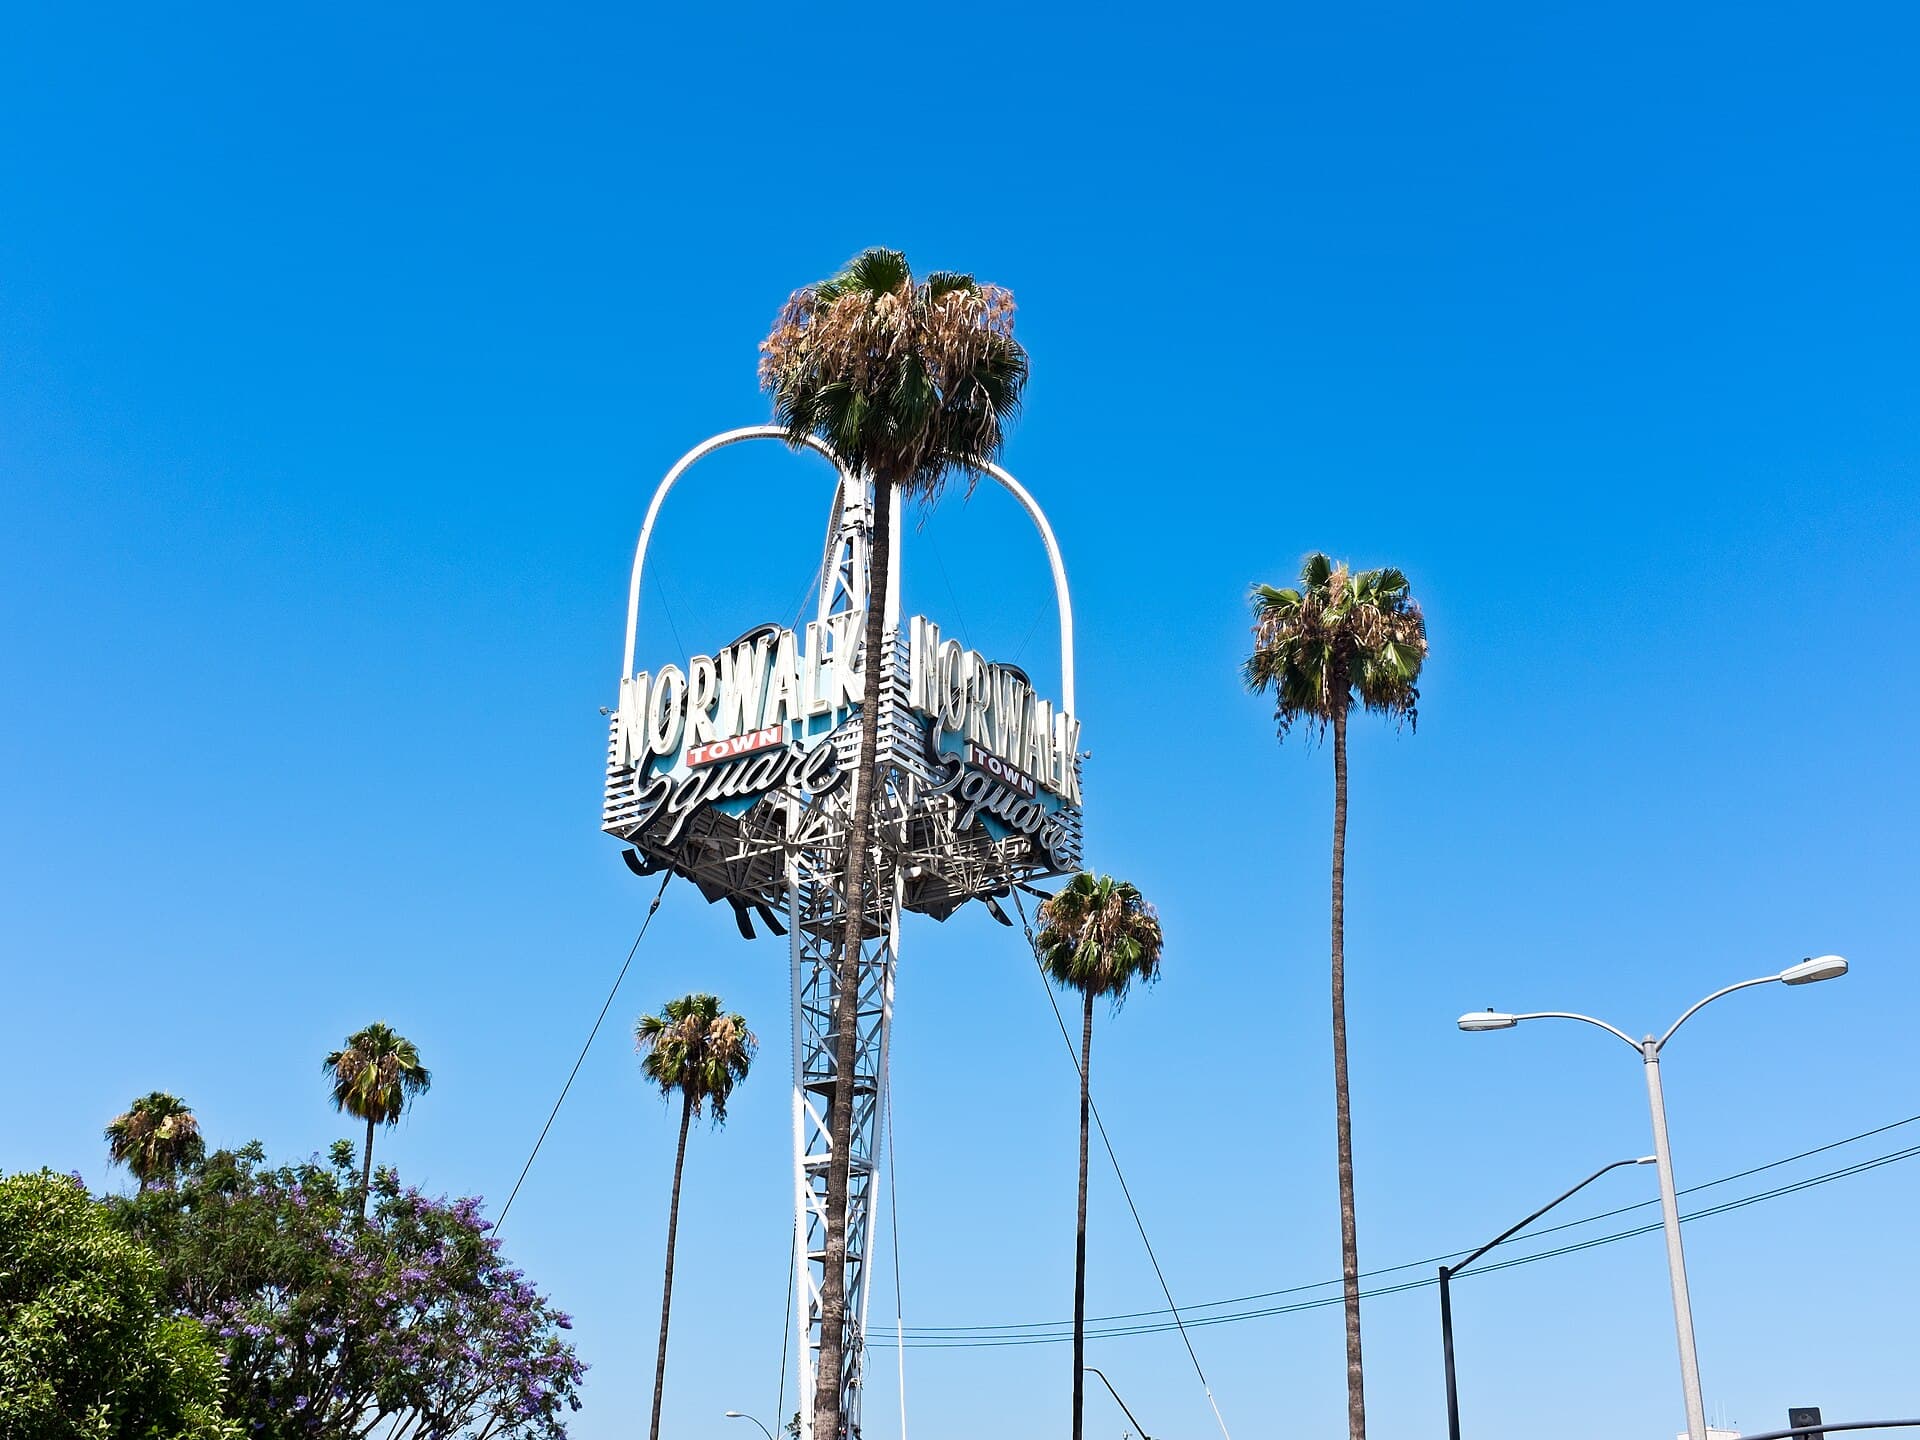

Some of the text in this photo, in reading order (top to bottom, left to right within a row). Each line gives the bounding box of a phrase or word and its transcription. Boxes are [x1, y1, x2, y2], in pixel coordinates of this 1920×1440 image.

[615, 609, 867, 768] NORWALK
[690, 727, 780, 764] TOWN
[910, 615, 1082, 806] NORWALK
[625, 722, 850, 847] Square
[922, 703, 1076, 873] Square
[974, 747, 1034, 796] TOWN
